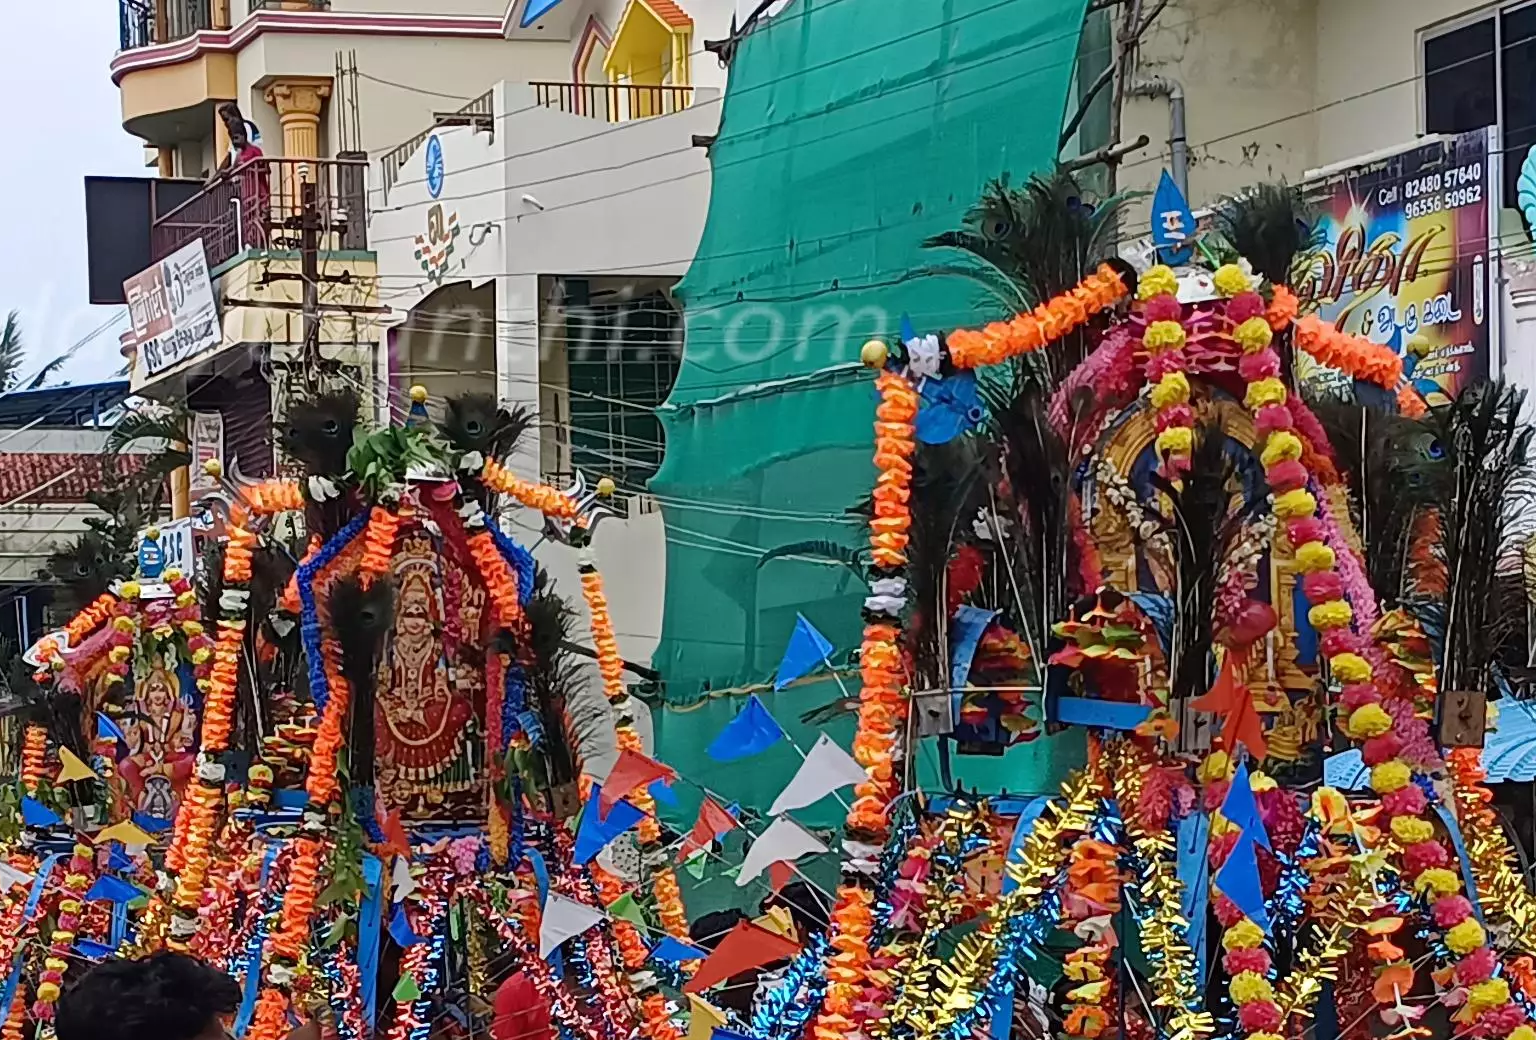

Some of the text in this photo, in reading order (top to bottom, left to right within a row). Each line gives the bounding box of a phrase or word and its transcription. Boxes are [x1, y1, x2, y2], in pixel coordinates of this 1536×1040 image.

[1404, 176, 1442, 200] 82480
[1404, 184, 1482, 221] 96556 50962
